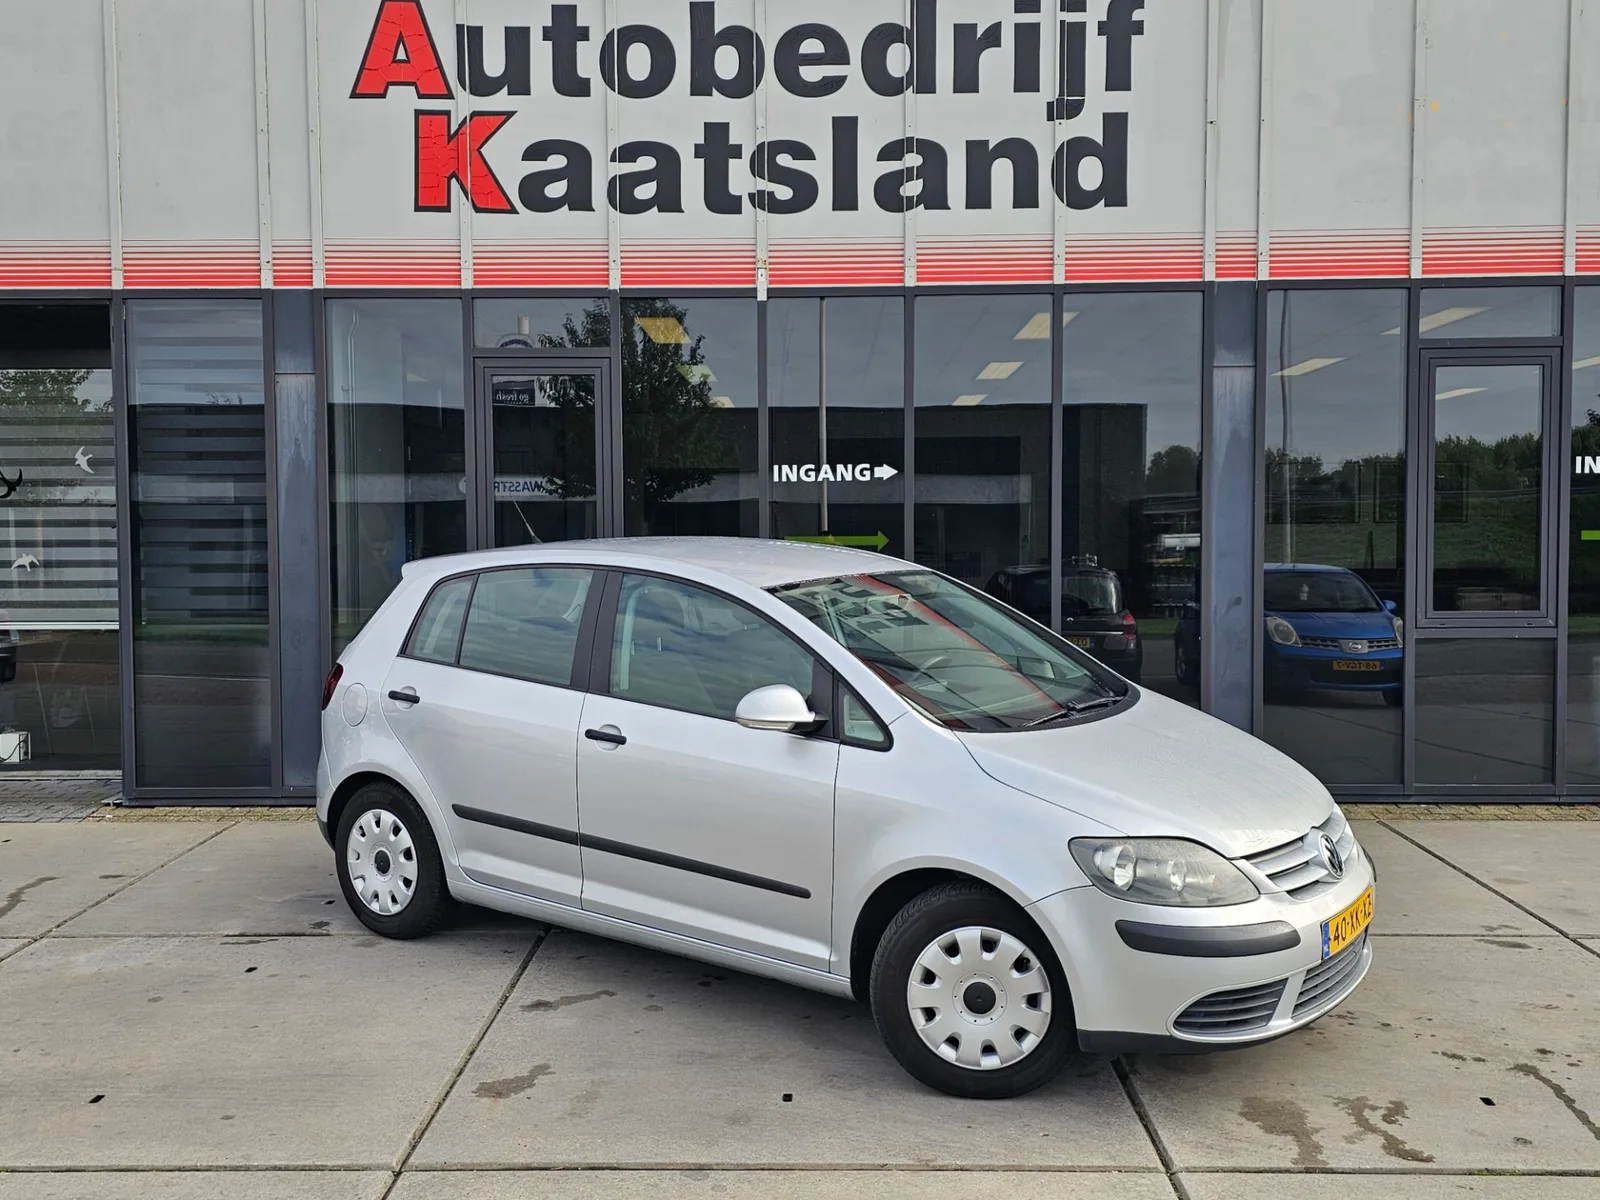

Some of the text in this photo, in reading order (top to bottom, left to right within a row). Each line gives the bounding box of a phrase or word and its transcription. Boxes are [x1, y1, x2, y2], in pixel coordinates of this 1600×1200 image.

[350, 0, 1145, 121] Autobedrijf
[414, 109, 1129, 214] Kaatsland
[773, 464, 871, 482] INGANG
